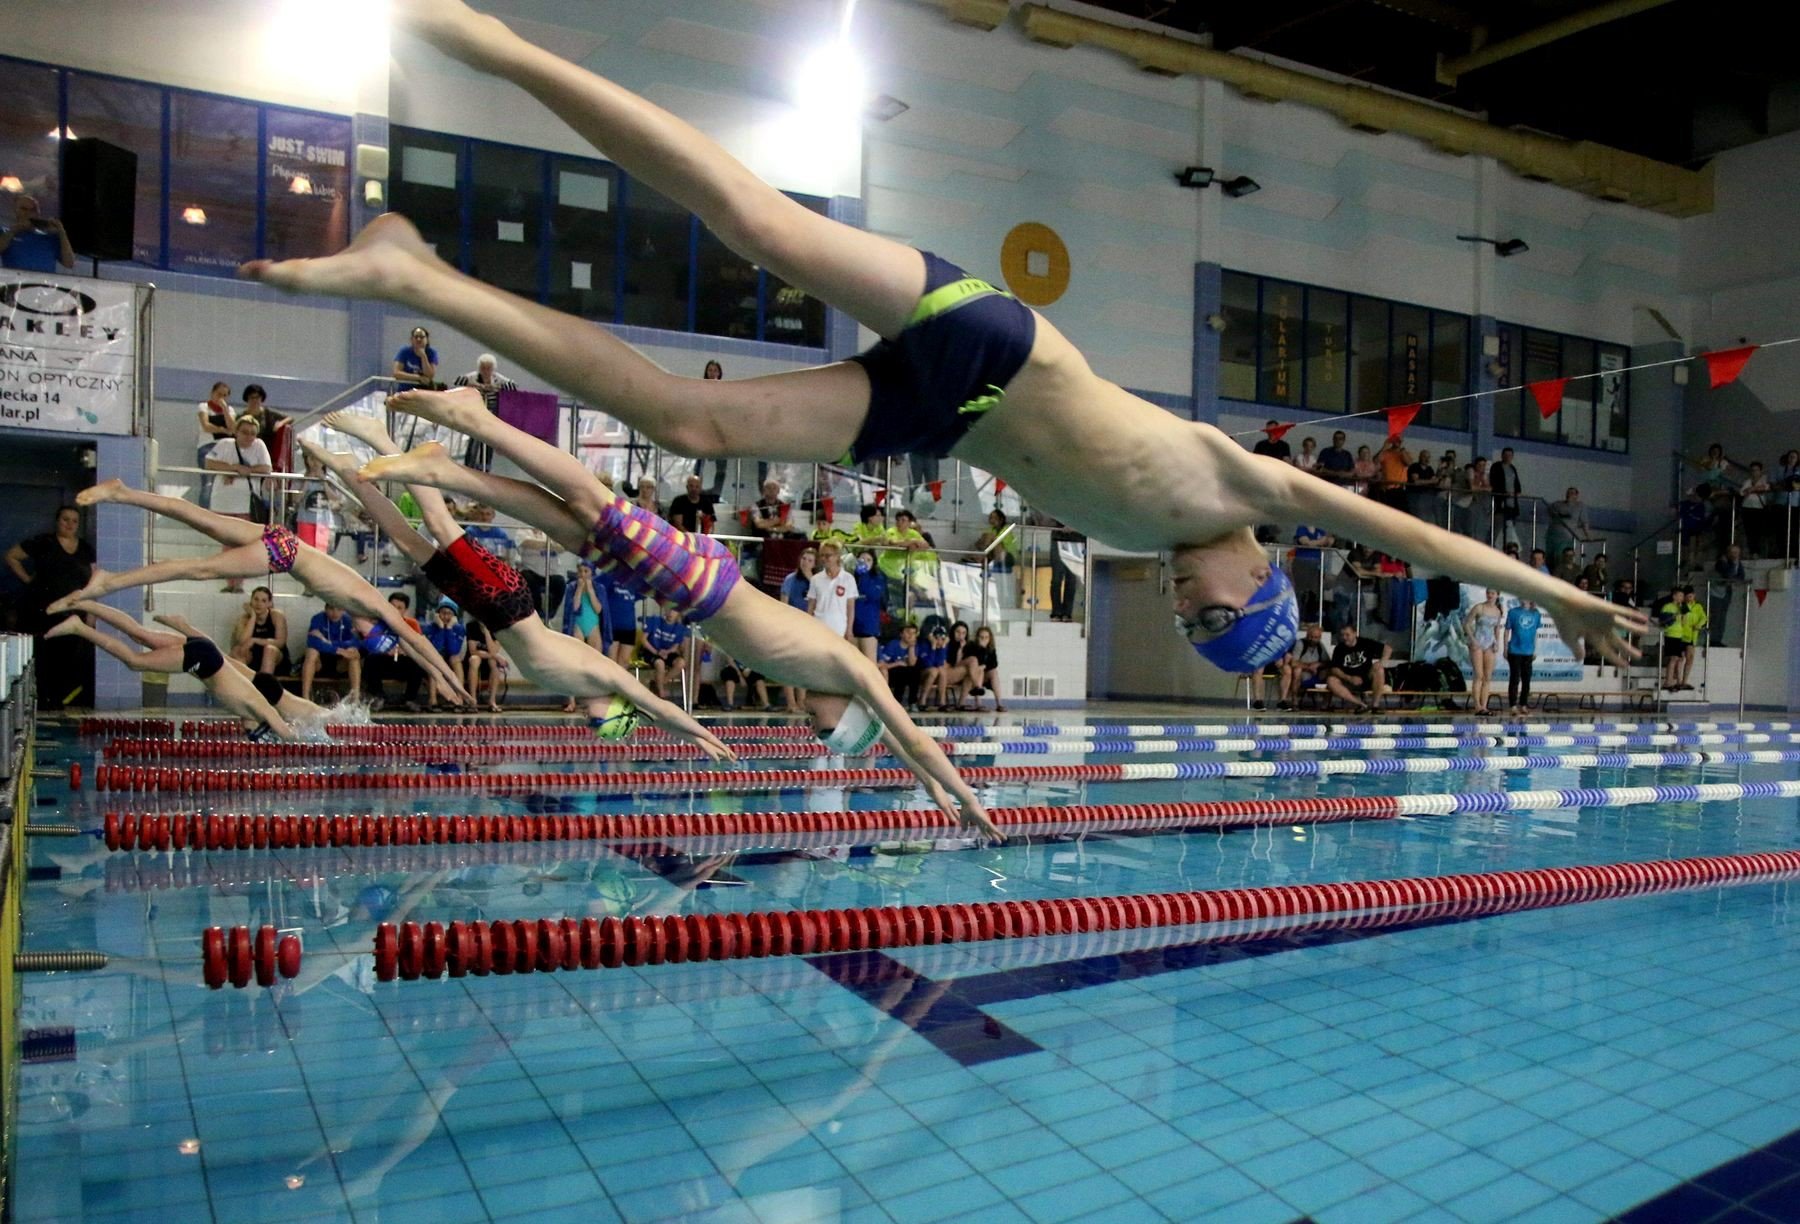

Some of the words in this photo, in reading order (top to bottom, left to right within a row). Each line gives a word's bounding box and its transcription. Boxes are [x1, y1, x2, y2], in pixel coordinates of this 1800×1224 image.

[269, 136, 304, 154] JUST
[307, 145, 346, 167] SWIM
[1276, 295, 1288, 397] SOLARIUM
[28, 371, 124, 391] OPTYCZNY
[44, 392, 60, 404] 14
[1, 404, 40, 422] lar.pl
